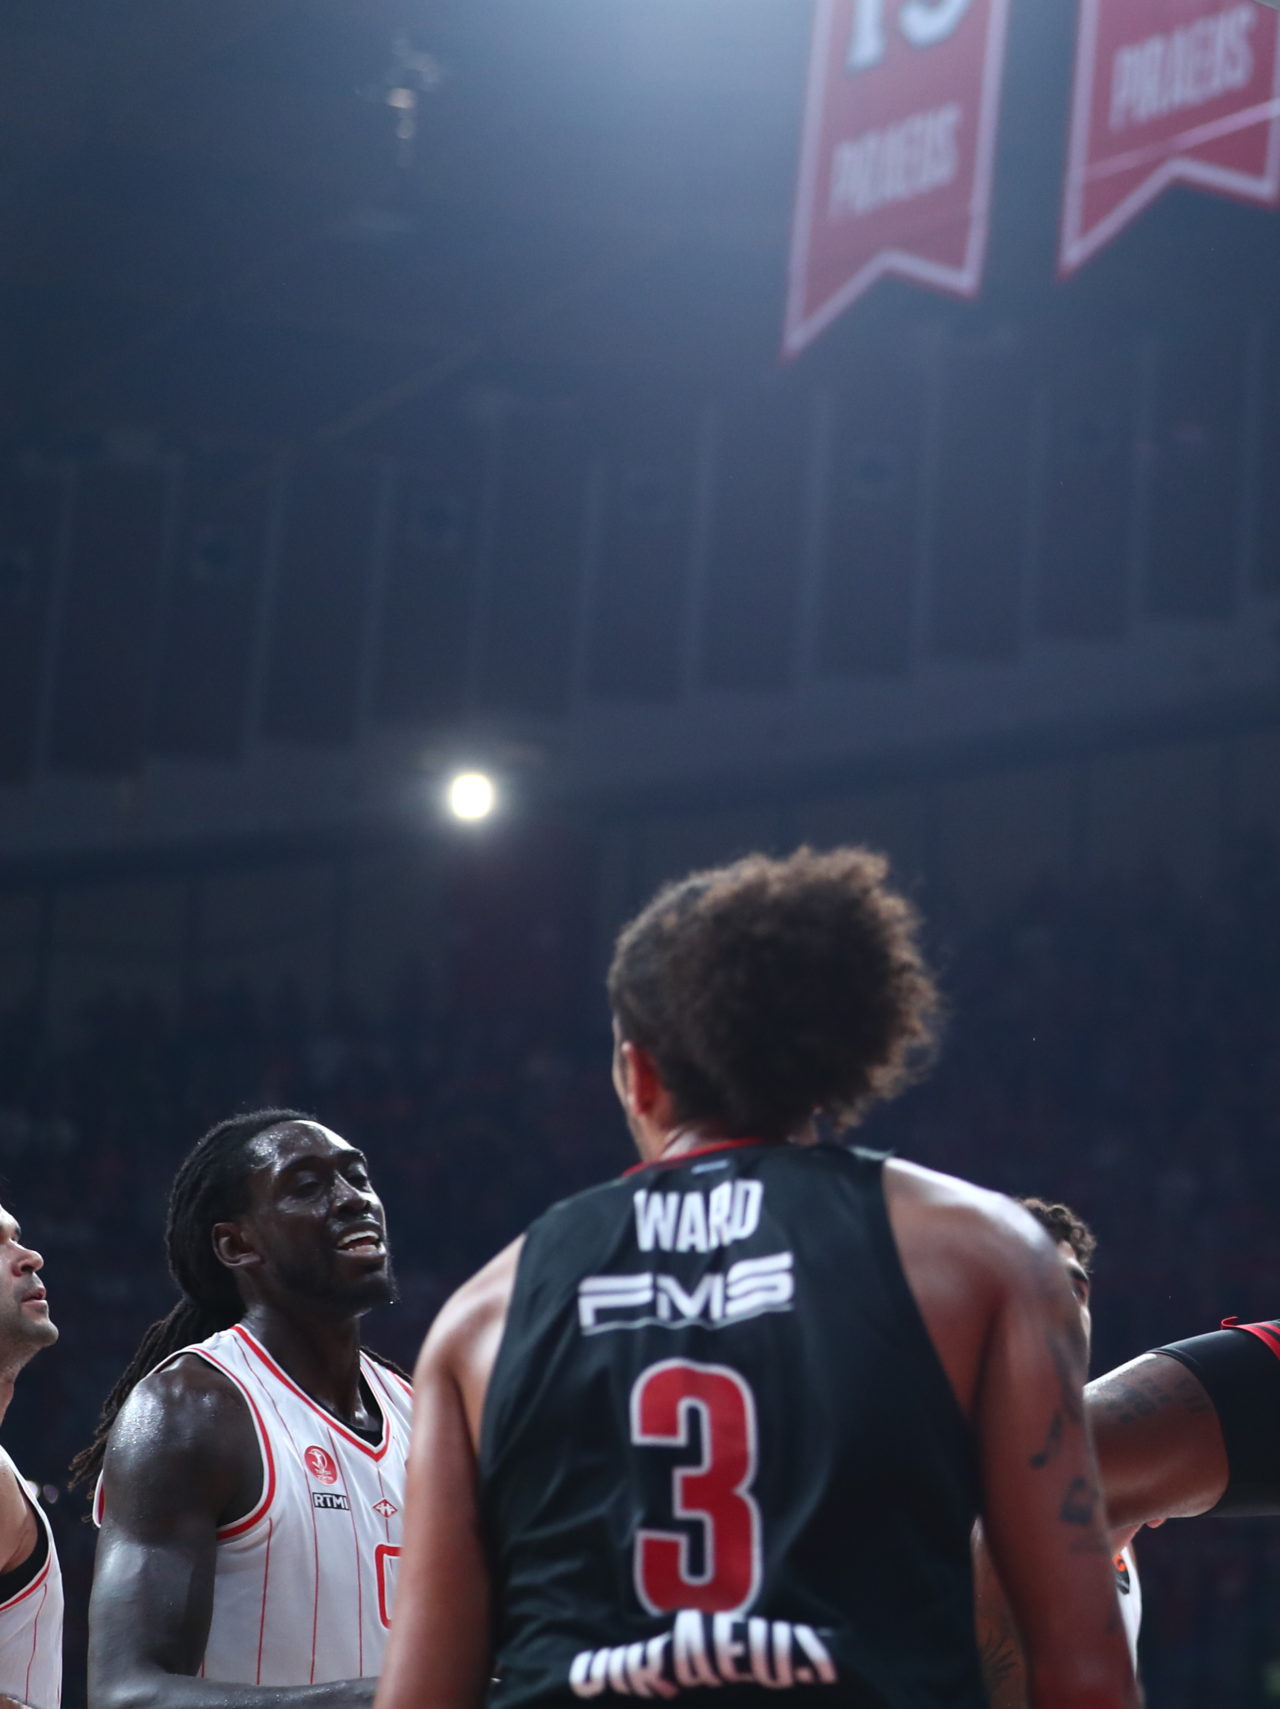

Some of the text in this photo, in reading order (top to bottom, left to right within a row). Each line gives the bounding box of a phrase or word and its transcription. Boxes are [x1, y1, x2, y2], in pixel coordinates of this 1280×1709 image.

[633, 1178, 764, 1253] WARD
[577, 1251, 795, 1328] FMS
[629, 1356, 763, 1617] 3
